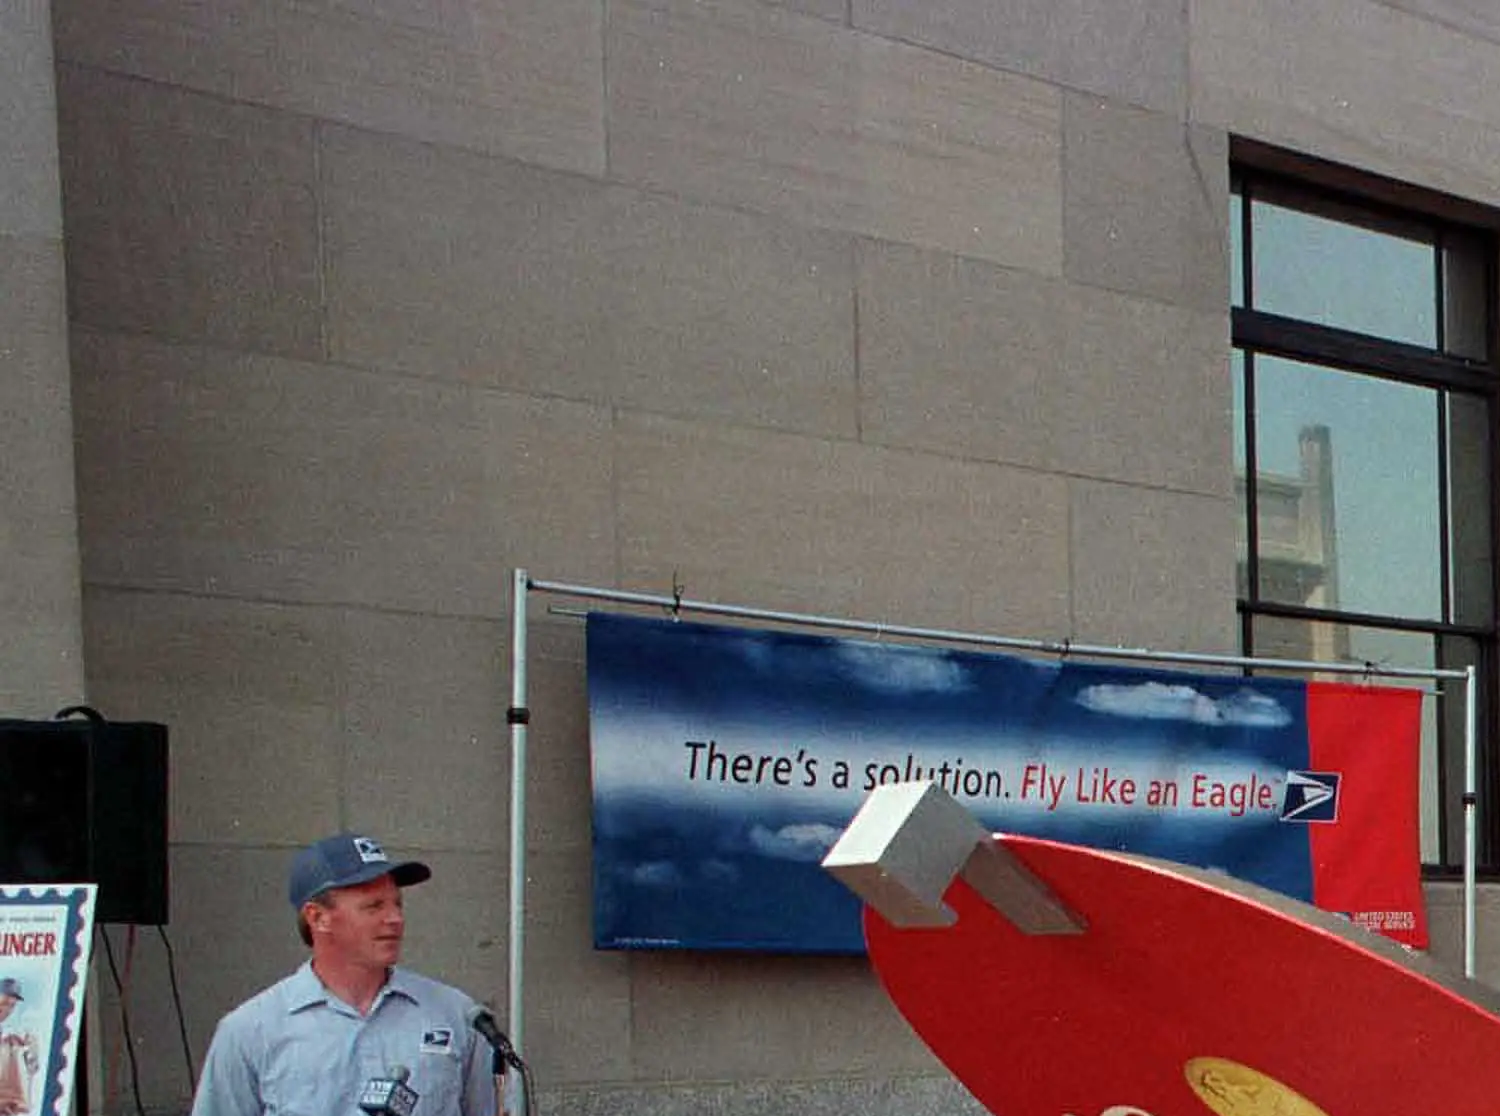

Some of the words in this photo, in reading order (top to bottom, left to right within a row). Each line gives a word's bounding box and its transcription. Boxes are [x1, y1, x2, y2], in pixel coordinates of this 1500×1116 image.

[685, 740, 818, 787] There's
[831, 761, 849, 790] a
[1021, 764, 1066, 811] Fly
[1076, 767, 1137, 806] Like
[1146, 780, 1178, 808] an
